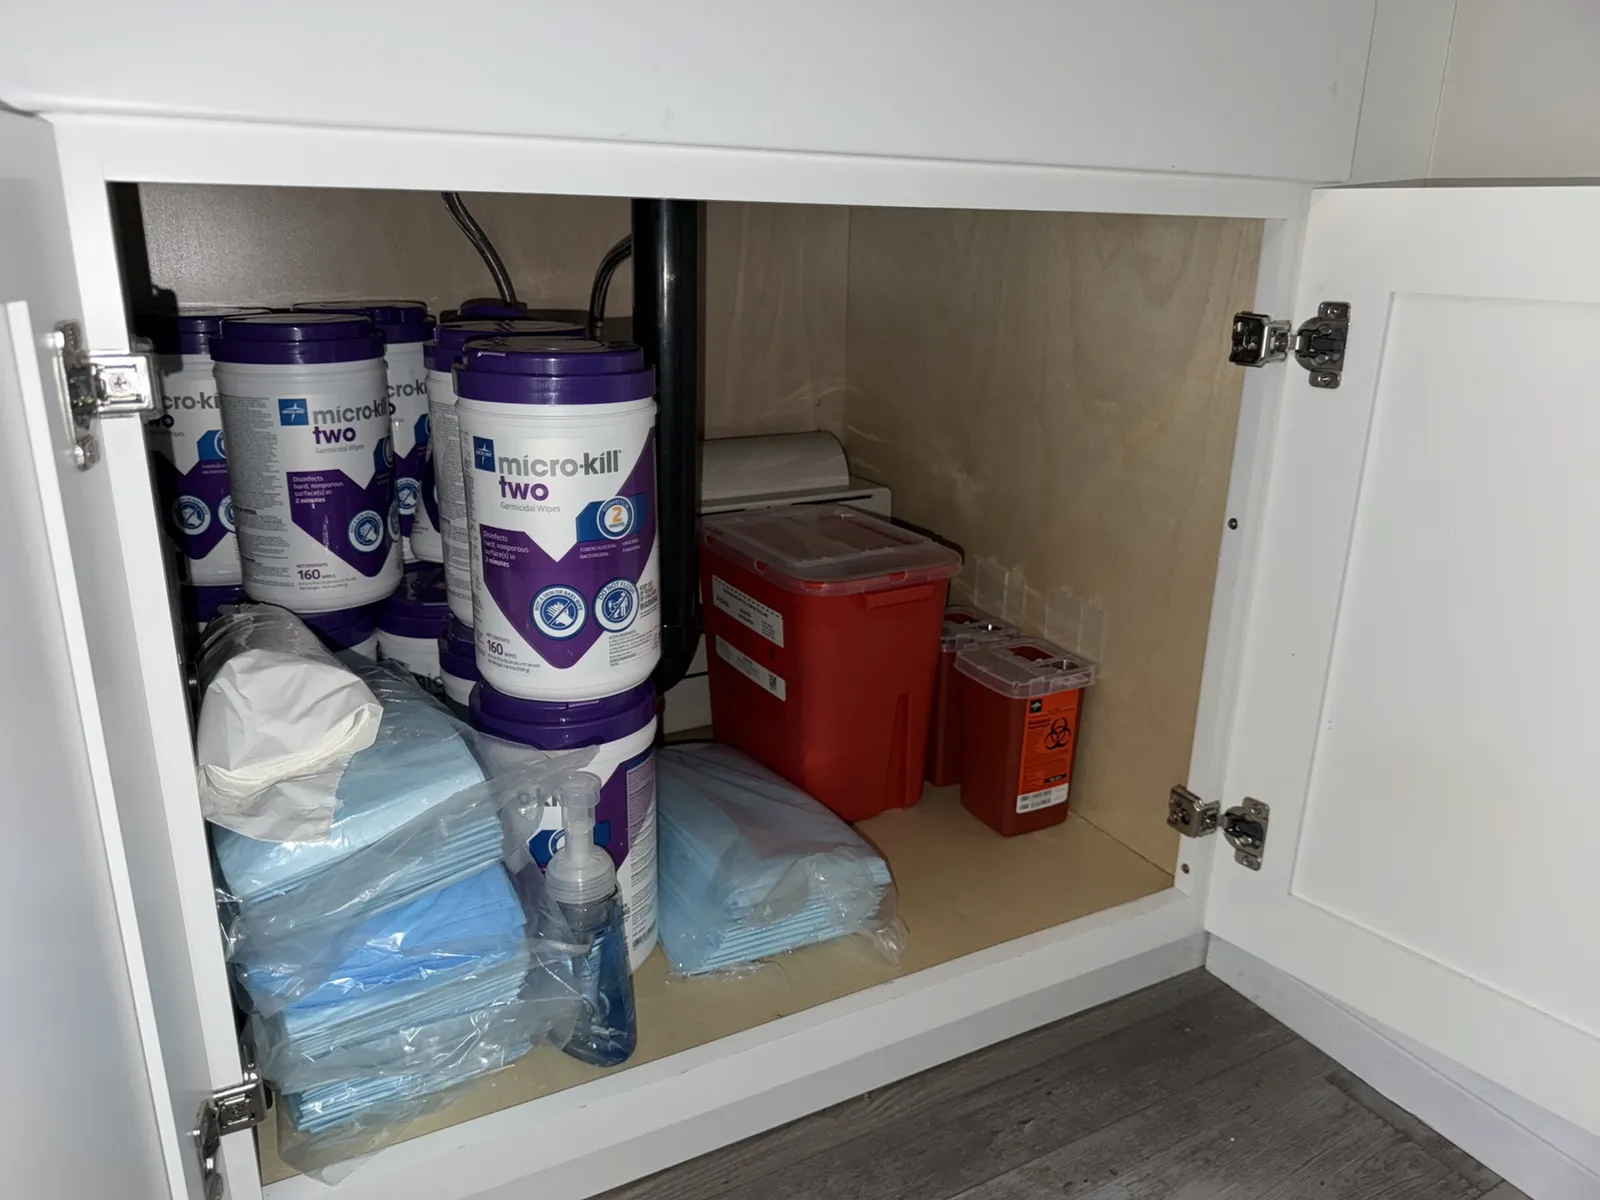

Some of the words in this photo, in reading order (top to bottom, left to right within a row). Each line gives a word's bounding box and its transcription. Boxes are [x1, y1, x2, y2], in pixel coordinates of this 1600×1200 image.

[163, 391, 219, 410] cro-ki
[312, 426, 356, 445] two
[498, 449, 620, 477] micro-kill
[292, 475, 324, 483] Disinfects
[310, 481, 344, 490] nonporous
[498, 475, 549, 501] two
[500, 501, 536, 513] Germicidal
[536, 504, 561, 515] Wipes
[611, 505, 623, 523] 2
[483, 530, 508, 542] Disinfects
[496, 543, 530, 554] nonporous
[297, 569, 321, 580] 160
[598, 589, 607, 600] DO
[606, 581, 620, 591] NOT
[620, 581, 636, 595] FLUSH
[543, 590, 555, 599] SKIN
[563, 590, 577, 600] BABY
[575, 598, 584, 611] WIPE
[487, 639, 503, 655] 160
